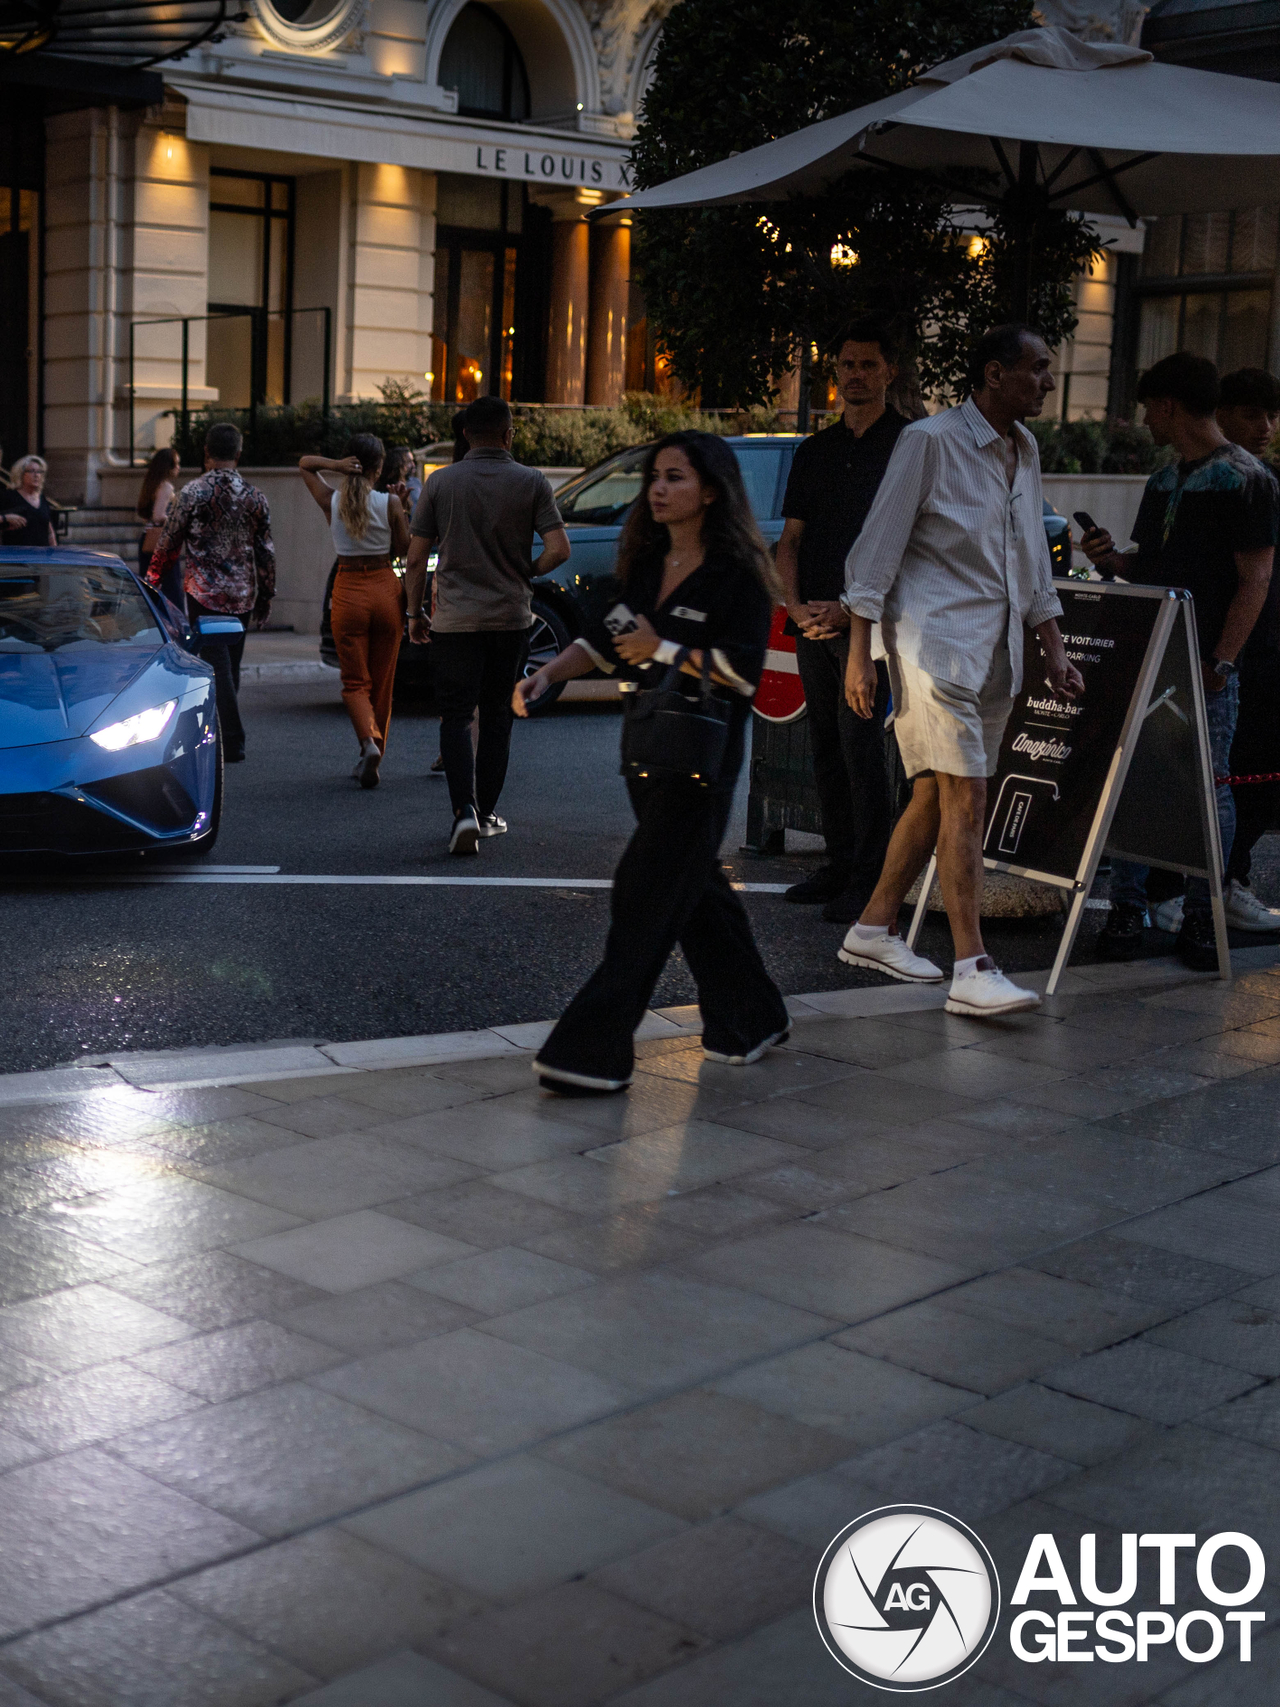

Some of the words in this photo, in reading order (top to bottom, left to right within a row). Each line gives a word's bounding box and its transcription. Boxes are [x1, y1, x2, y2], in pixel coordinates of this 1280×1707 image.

[476, 147, 507, 171] LE
[524, 152, 603, 183] LOUIS
[1071, 635, 1115, 648] VOITURIER
[1066, 651, 1101, 663] PARKING
[1027, 696, 1082, 715] buddha-bar
